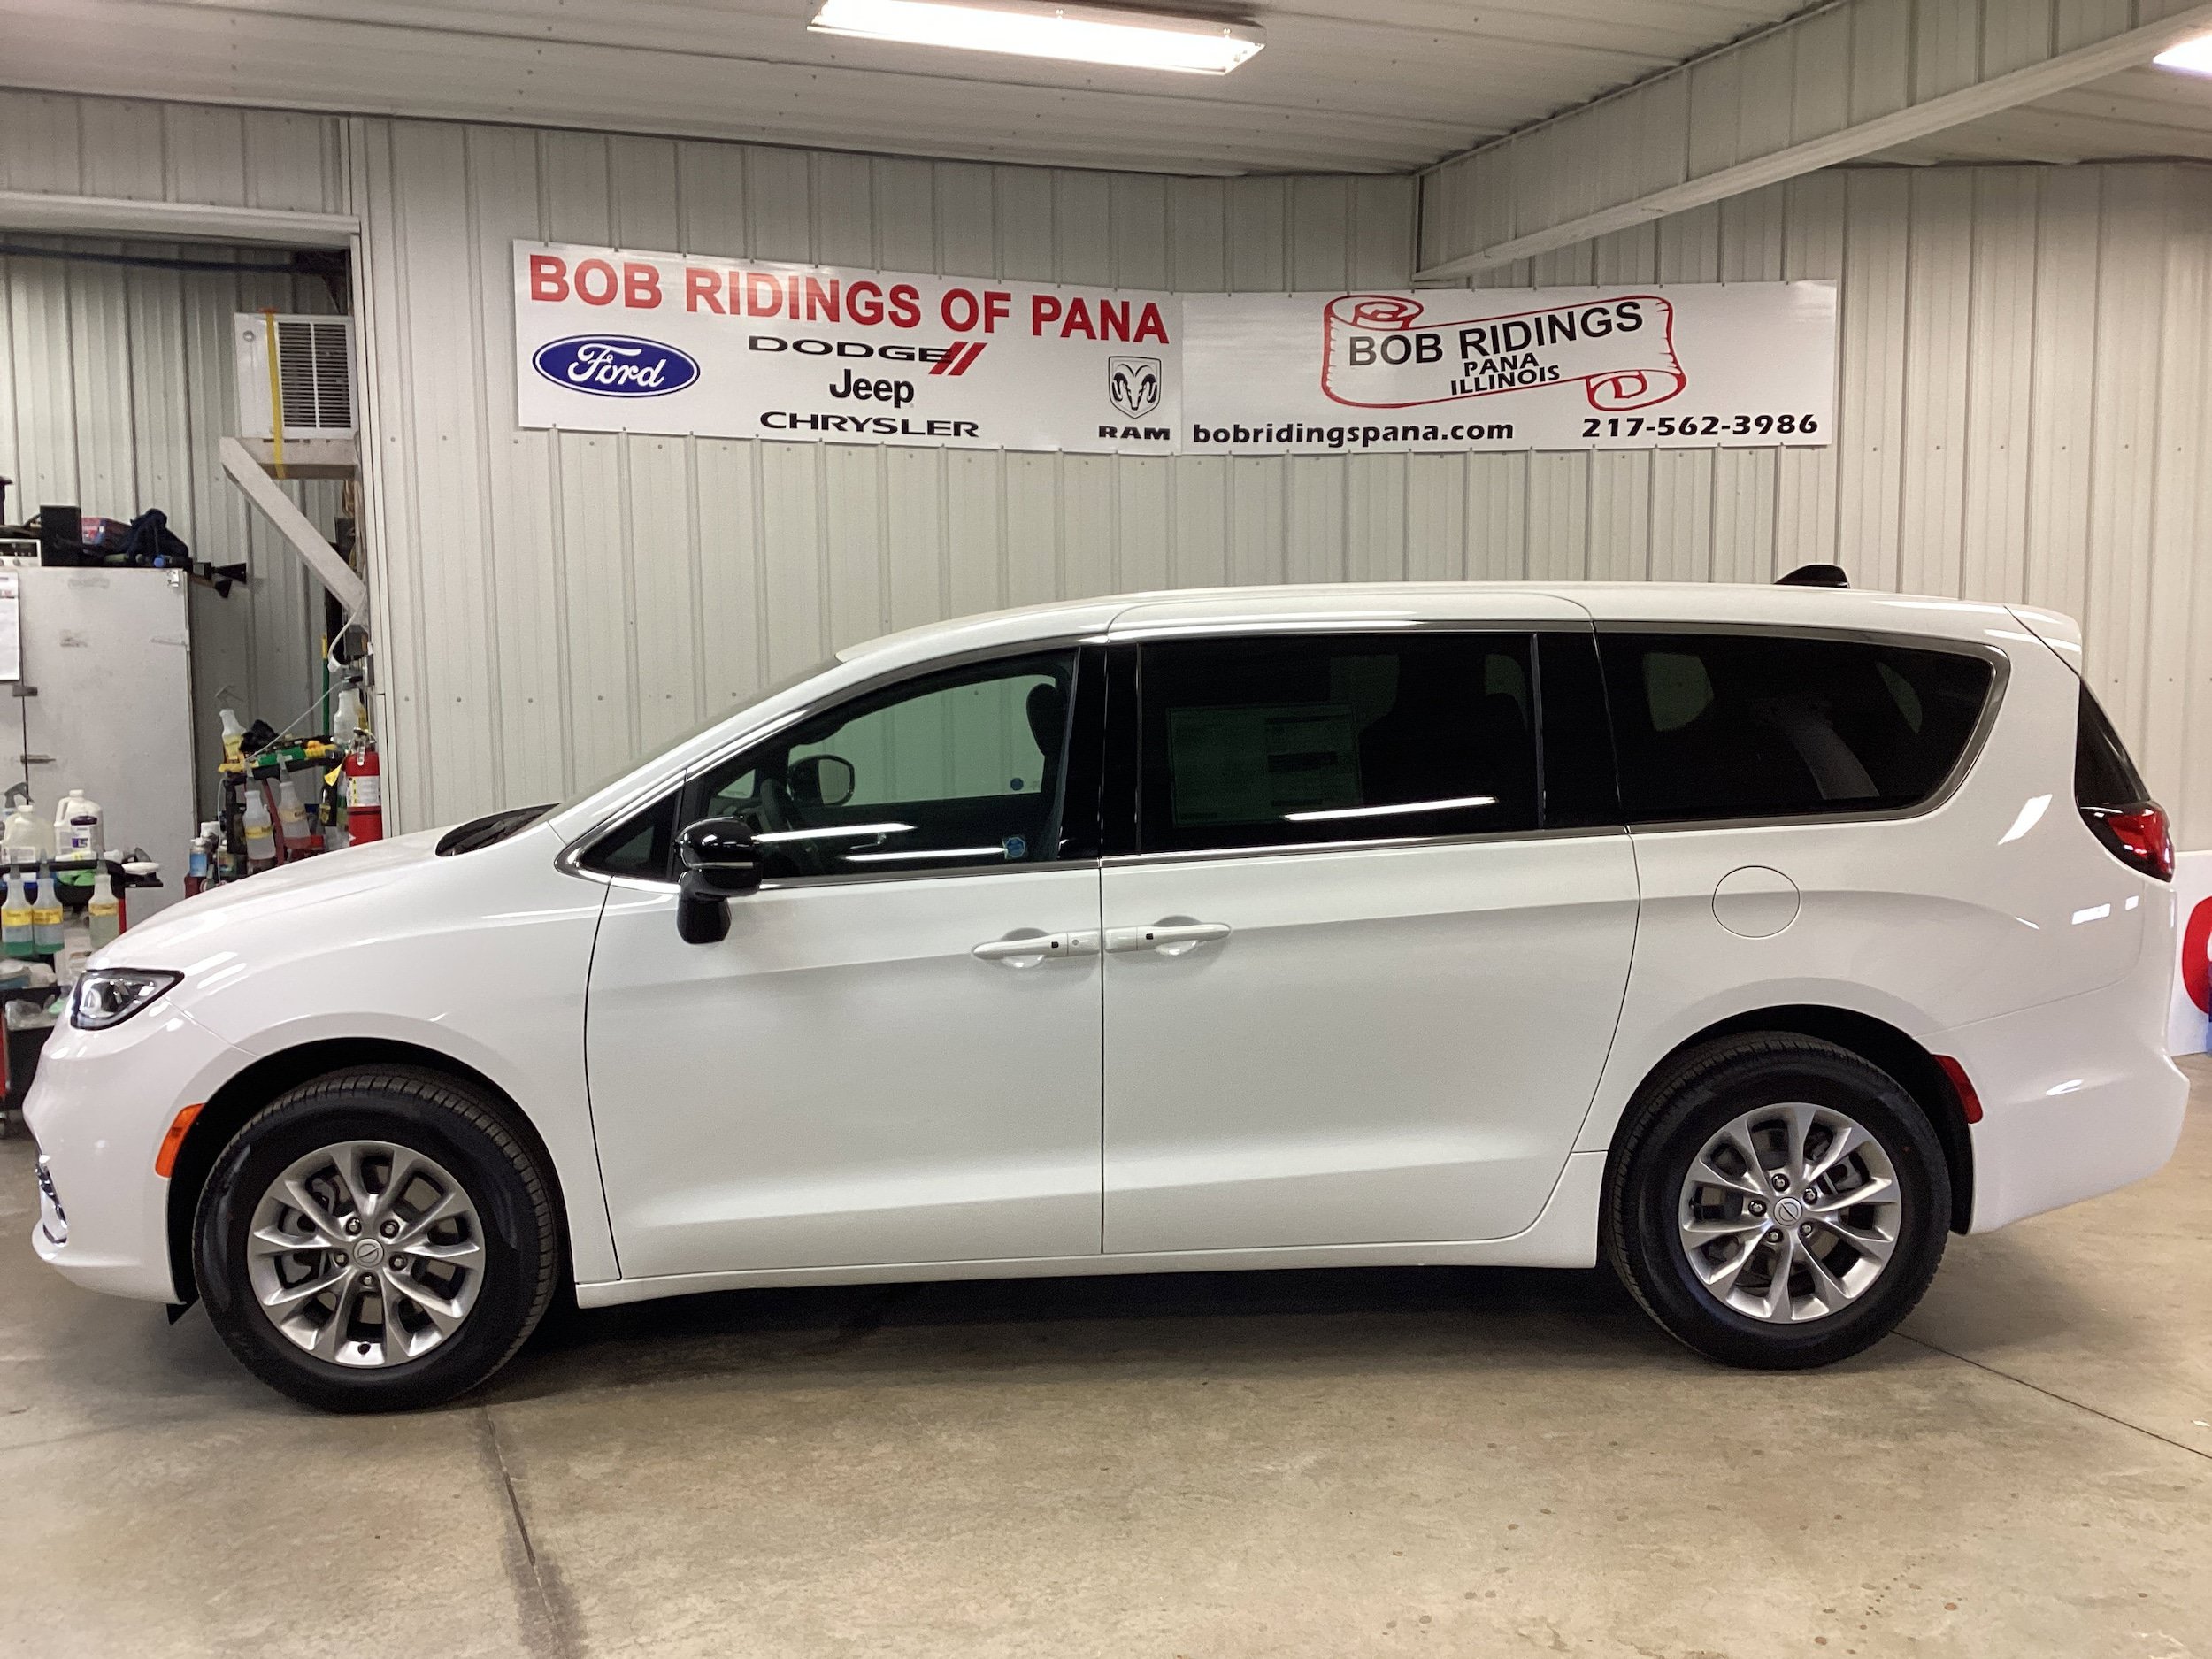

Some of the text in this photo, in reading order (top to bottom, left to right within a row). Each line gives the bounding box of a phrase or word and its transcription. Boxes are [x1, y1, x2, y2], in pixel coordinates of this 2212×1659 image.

[529, 253, 1169, 345] BOB RIDINGS OF PANA
[1348, 301, 1644, 366] BOB RIDINGS
[748, 335, 953, 364] DODGE
[567, 342, 666, 388] Ford
[1463, 352, 1540, 378] PANA
[829, 368, 915, 409] Jeep
[1450, 365, 1560, 396] ILLINOIS
[760, 411, 979, 438] CHRYSLER
[1098, 426, 1171, 440] RAM
[1193, 423, 1514, 449] bobridingspana.com
[1582, 413, 1818, 438] 217-562-3986
